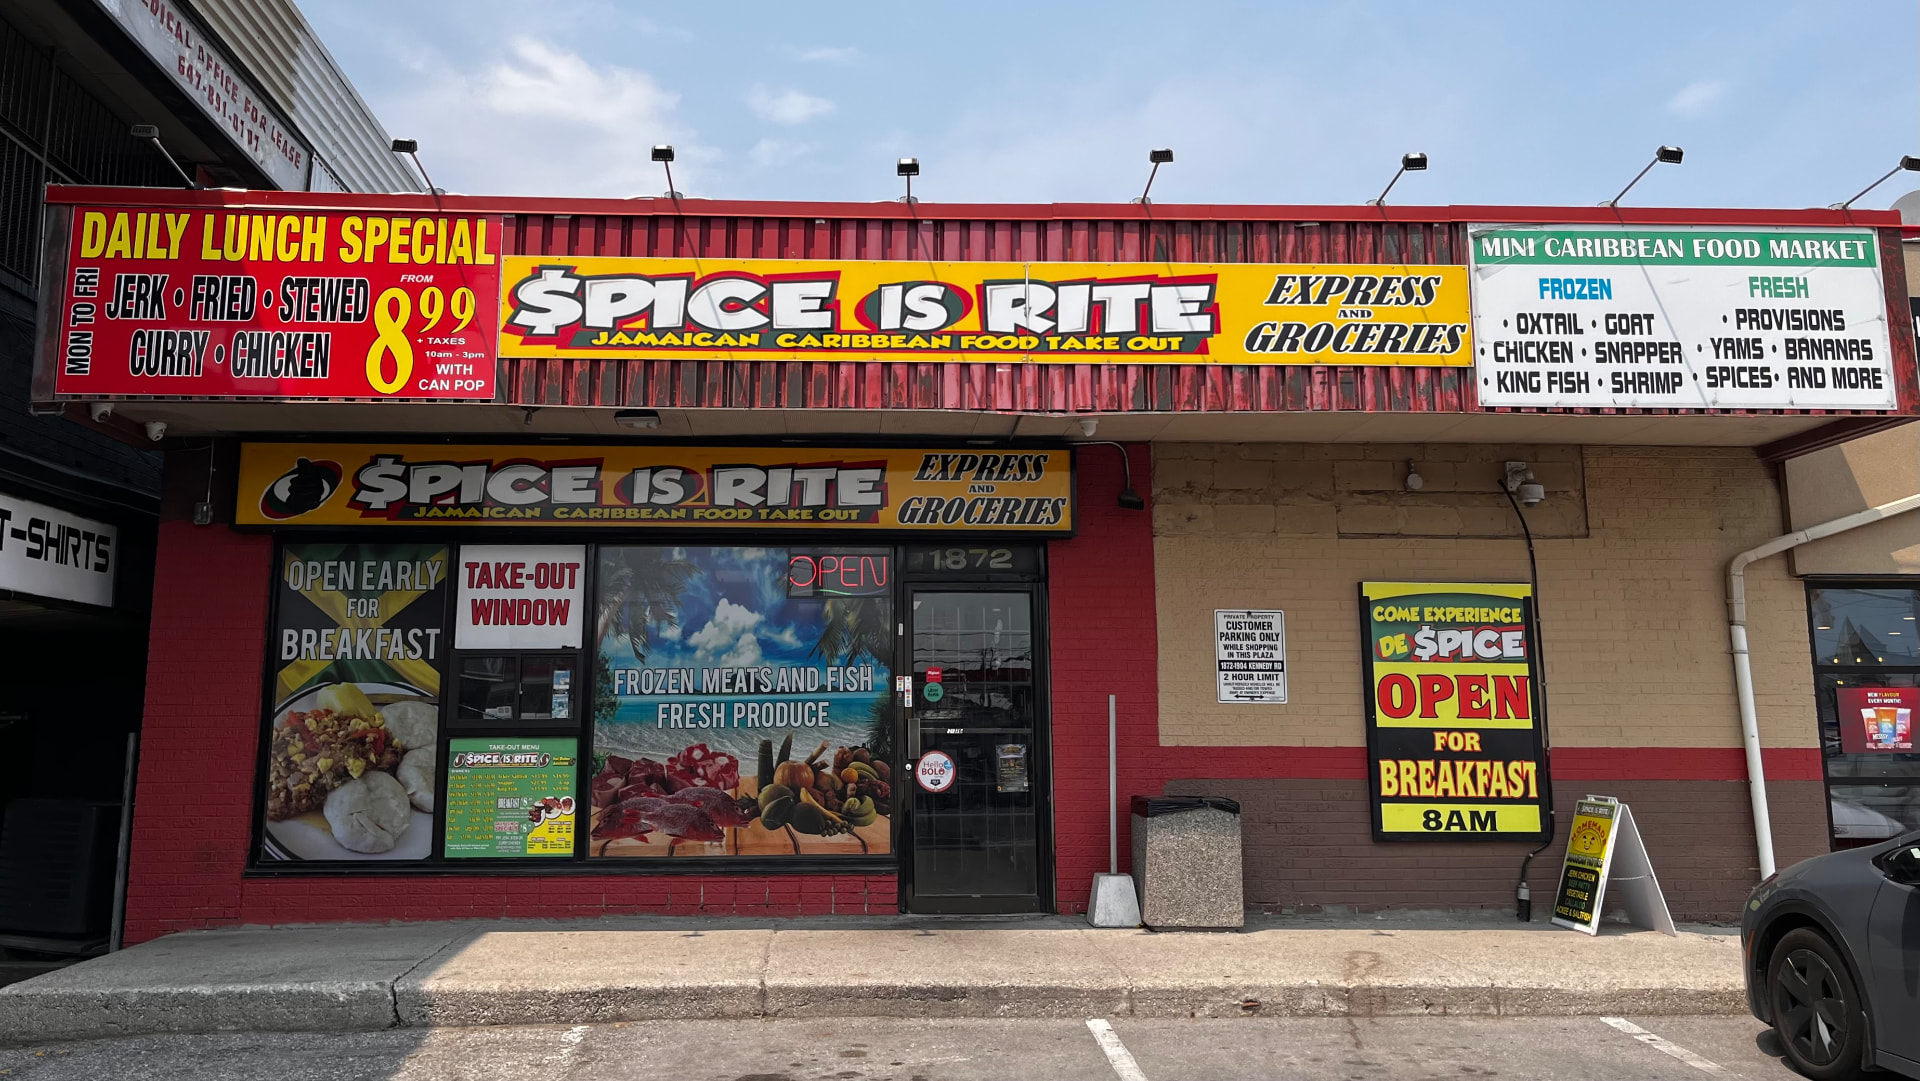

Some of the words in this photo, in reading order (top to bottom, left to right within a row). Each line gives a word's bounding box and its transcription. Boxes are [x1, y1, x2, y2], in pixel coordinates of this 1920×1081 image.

[198, 45, 239, 104] OFFICE
[244, 96, 267, 134] FOR
[271, 125, 302, 170] LEASE
[80, 211, 191, 260] DAILY
[201, 213, 327, 263] LUNCH
[339, 215, 496, 265] SPECIAL
[1481, 237, 1536, 258] MINI
[1544, 238, 1685, 259] CARIBBEAN
[1693, 239, 1761, 259] FOOD
[1769, 239, 1868, 261] MARKET
[73, 267, 100, 298] FRI
[400, 274, 434, 283] FROM
[1538, 277, 1613, 300] FROZEN
[1748, 276, 1810, 299] FRESH
[105, 273, 169, 320] JERK
[189, 275, 257, 321] FRIED
[278, 276, 370, 323] STEWED
[1263, 275, 1442, 307] EXPRESS
[70, 302, 96, 327] TO
[878, 283, 951, 332] IS
[985, 282, 1214, 334] RITE
[1337, 308, 1373, 319] AND
[1736, 308, 1846, 331] PROVISIONS
[1516, 312, 1584, 335] OXTAIL
[1605, 313, 1655, 336] GOAT
[427, 337, 466, 345] TAXES
[591, 331, 762, 348] JAMAICAN
[775, 332, 952, 350] CARIBBEAN
[960, 335, 1041, 350] FOOD
[1046, 336, 1120, 351] TAKE
[1125, 336, 1184, 351] OUT
[1244, 322, 1467, 355] GROCERIES
[1710, 337, 1764, 360] YAMS
[1784, 338, 1873, 361] BANANAS
[65, 331, 94, 376] MON
[129, 329, 210, 377] CURRY
[230, 331, 331, 379] CHICKEN
[462, 351, 485, 359] 3pm
[1493, 341, 1574, 363] CHICKEN
[1595, 341, 1682, 364] SNAPPER
[436, 364, 473, 375] WITH
[1706, 366, 1773, 389] SPICES
[1788, 366, 1826, 389] AND
[1832, 366, 1883, 390] MORE
[418, 379, 450, 391] CAN
[454, 379, 485, 391] POP
[1497, 370, 1541, 394] KING
[1547, 371, 1590, 394] FISH
[1611, 371, 1683, 394] SHRIMP
[914, 453, 1048, 483] EXPRESS
[631, 467, 685, 505] IS
[712, 465, 883, 507] RITE
[968, 484, 995, 495] AND
[413, 506, 541, 519] JAMAICAN
[552, 507, 686, 520] CARIBBEAN
[693, 508, 752, 521] FOOD
[758, 508, 813, 521] TAKE
[818, 508, 861, 521] OUT
[897, 497, 1068, 526] GROCERIES
[789, 555, 887, 587] OPEN
[929, 548, 1013, 570] 1872
[288, 560, 355, 591] OPEN
[361, 560, 442, 591] EARLY
[465, 562, 580, 589] TAKE-OUT
[347, 598, 379, 618] FOR
[471, 598, 571, 626] WINDOW
[1373, 606, 1420, 622] COME
[1424, 607, 1522, 623] EXPERIENCE
[1220, 632, 1256, 641] PARKING
[1259, 632, 1280, 642] ONLY
[1226, 621, 1273, 630] CUSTOMER
[281, 628, 441, 661] BREAKFAST
[1379, 633, 1408, 658] DE
[1248, 662, 1272, 670] KENNEDY
[1257, 673, 1280, 681] LIMIT
[614, 668, 694, 695] FROZEN
[702, 667, 773, 694] MEATS
[776, 666, 819, 693] AND
[827, 666, 873, 692] FISH
[1377, 673, 1531, 720] OPEN
[657, 702, 725, 729] FRESH
[733, 701, 830, 728] PRODUCE
[1433, 731, 1482, 752] FOR
[513, 754, 538, 763] RITE
[923, 760, 943, 768] Hello
[921, 768, 945, 776] BOLO
[1379, 759, 1539, 798] BREAKFAST
[1422, 809, 1498, 832] 8AM
[1578, 871, 1595, 881] CHICKEN
